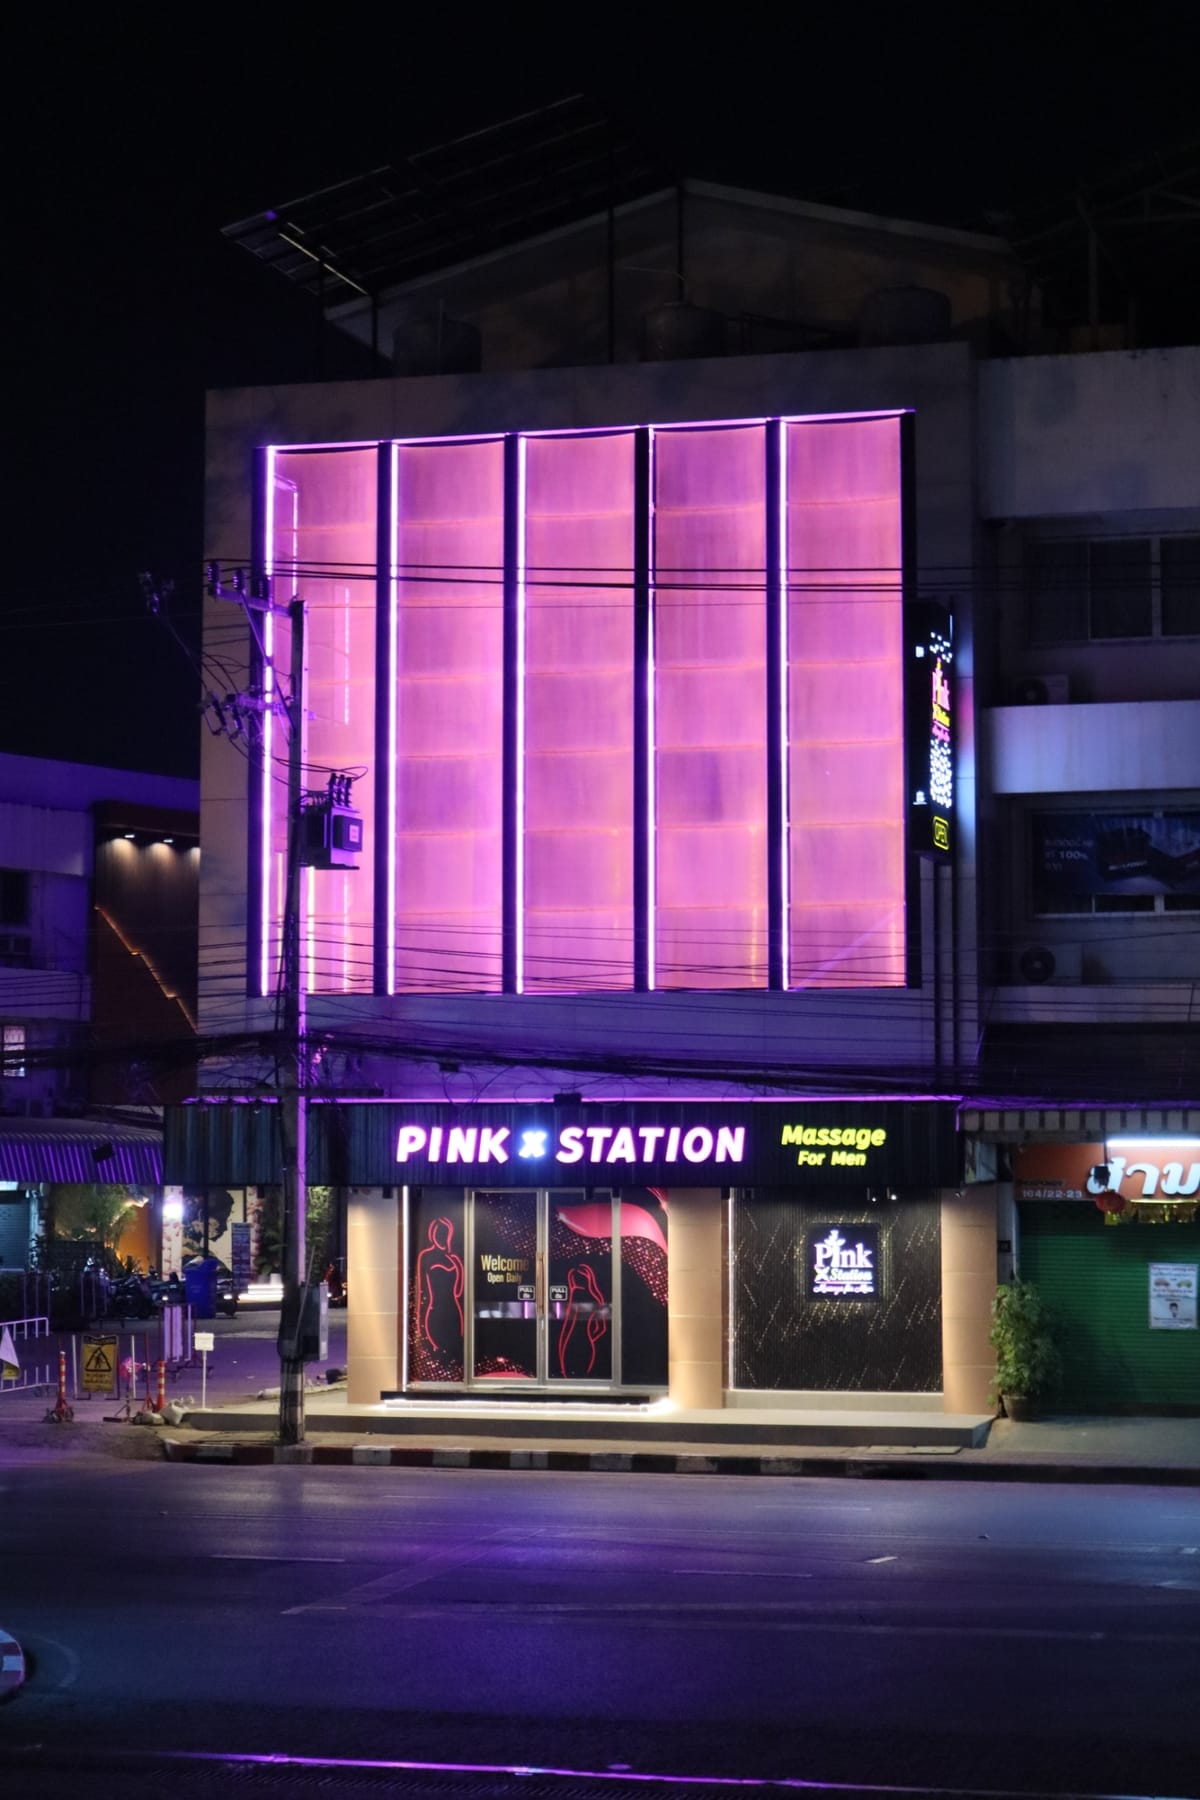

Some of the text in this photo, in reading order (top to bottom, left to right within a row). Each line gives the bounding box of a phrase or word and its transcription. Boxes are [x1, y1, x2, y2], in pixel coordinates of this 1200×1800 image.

[396, 1126, 511, 1164] PINK
[555, 1126, 746, 1164] STATION
[781, 1125, 886, 1150] Massage
[797, 1150, 867, 1166] For Men
[813, 1229, 874, 1268] Pink
[480, 1254, 529, 1272] Welcome
[487, 1272, 504, 1284] Open
